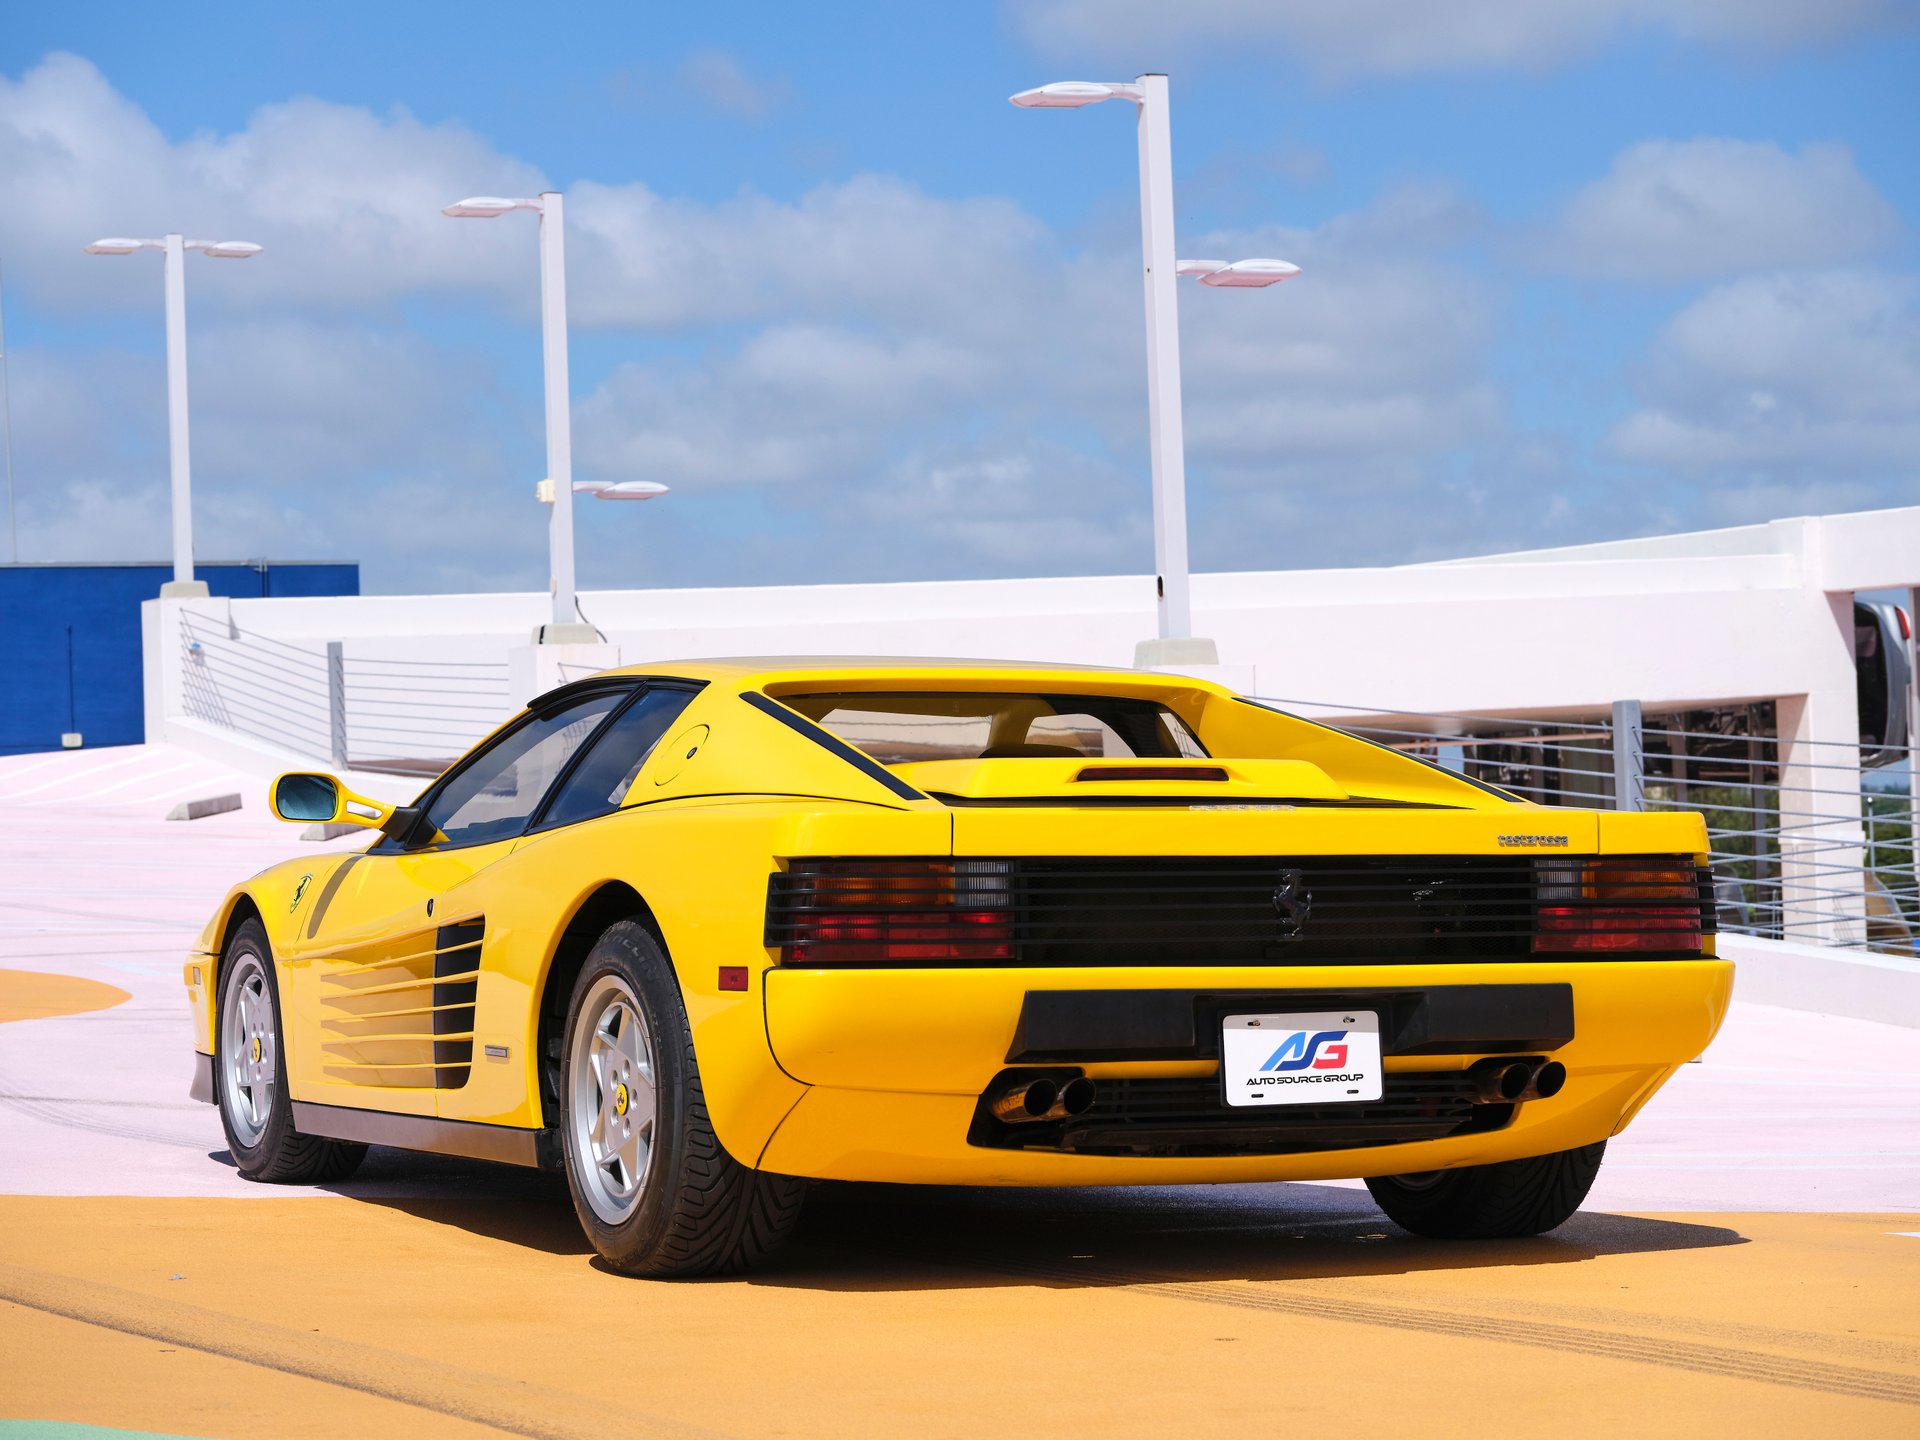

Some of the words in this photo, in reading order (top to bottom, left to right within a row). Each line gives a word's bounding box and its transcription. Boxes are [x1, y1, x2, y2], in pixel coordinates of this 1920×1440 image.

[1259, 1031, 1348, 1071] ASG
[1247, 1076, 1276, 1086] AUTO
[1277, 1075, 1322, 1085] SOURCE
[1323, 1073, 1364, 1084] GROUP
